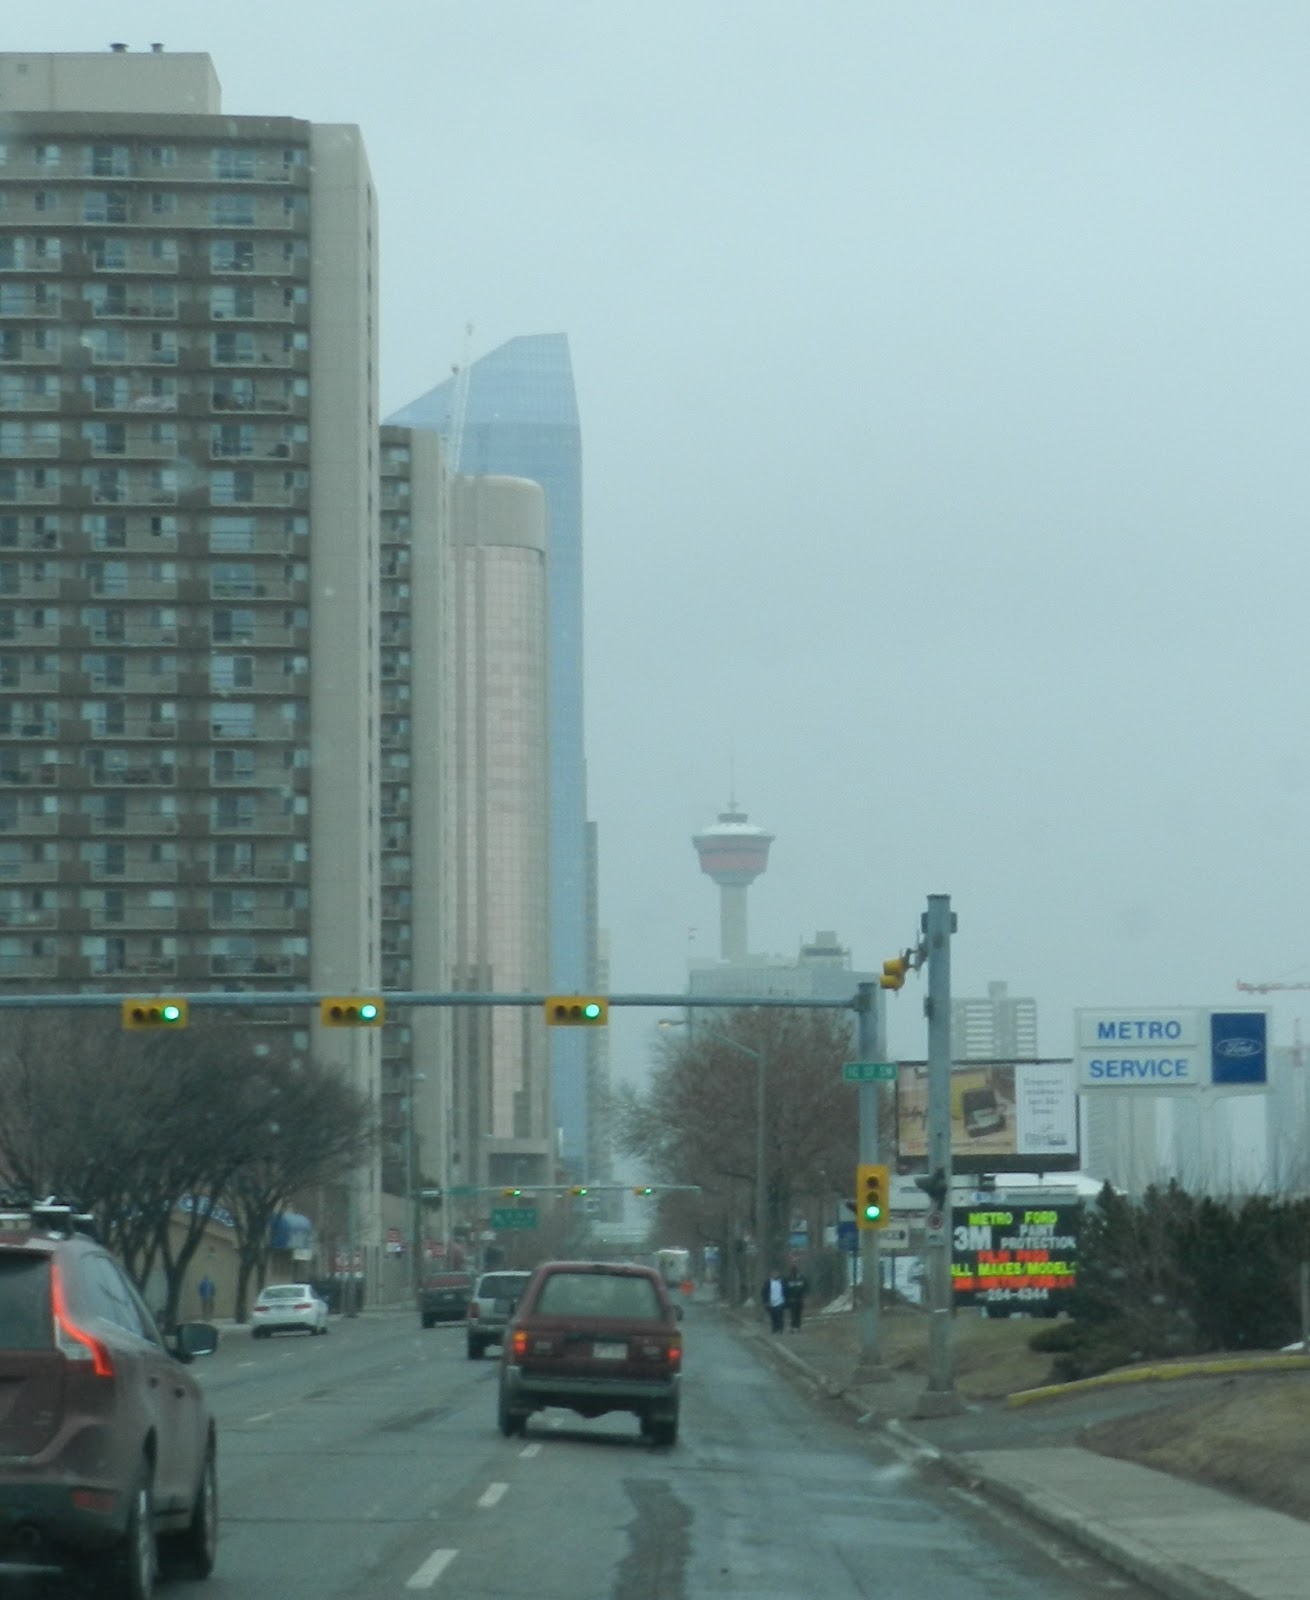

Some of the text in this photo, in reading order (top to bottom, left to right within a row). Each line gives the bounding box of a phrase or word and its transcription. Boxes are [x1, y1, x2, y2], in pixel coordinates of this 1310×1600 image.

[1097, 1021, 1182, 1040] METRO
[1089, 1058, 1189, 1078] SERVICE
[969, 1210, 1058, 1225] METRO FORD
[953, 1225, 992, 1251] 3M
